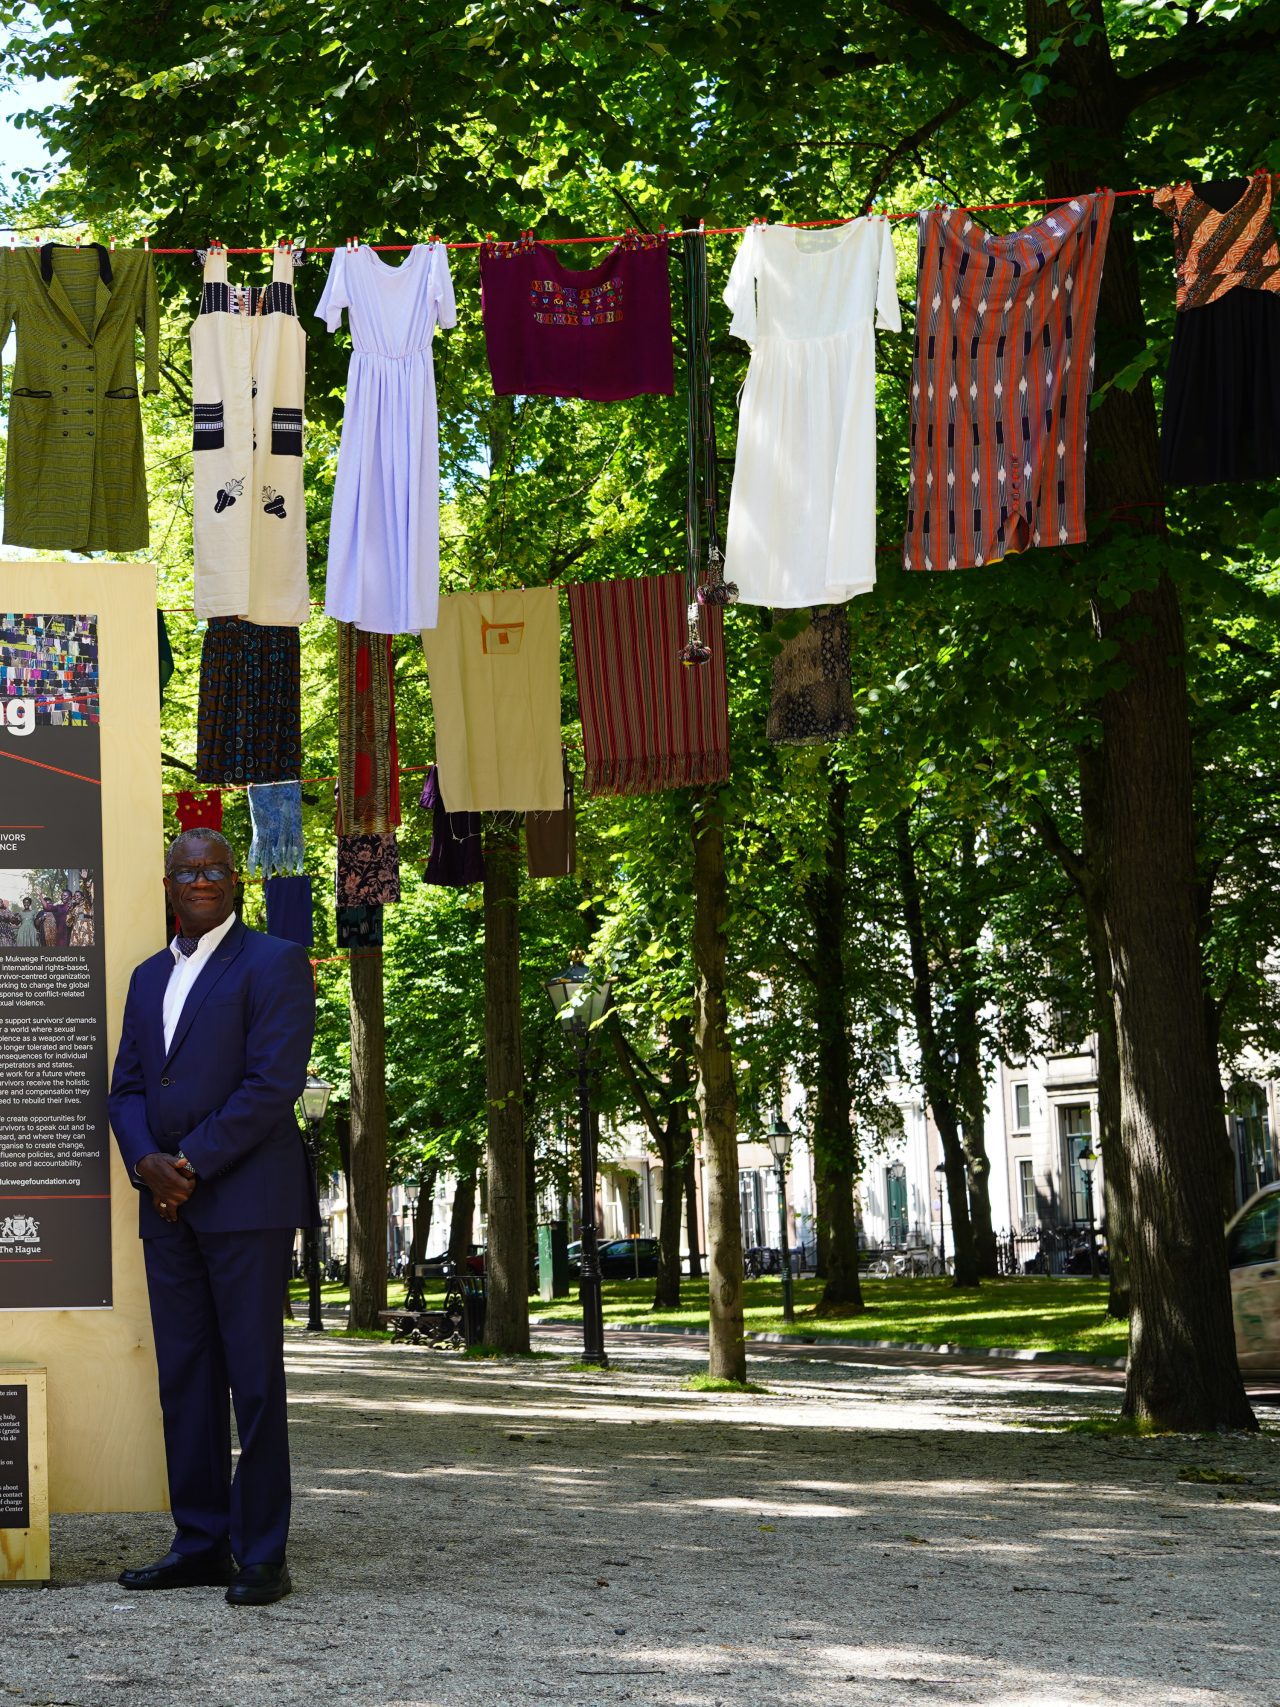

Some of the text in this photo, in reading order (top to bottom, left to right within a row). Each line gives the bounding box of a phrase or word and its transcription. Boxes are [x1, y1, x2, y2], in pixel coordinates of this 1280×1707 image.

[48, 972, 90, 981] organization
[27, 1150, 54, 1159] policies,
[15, 1246, 41, 1254] Hague
